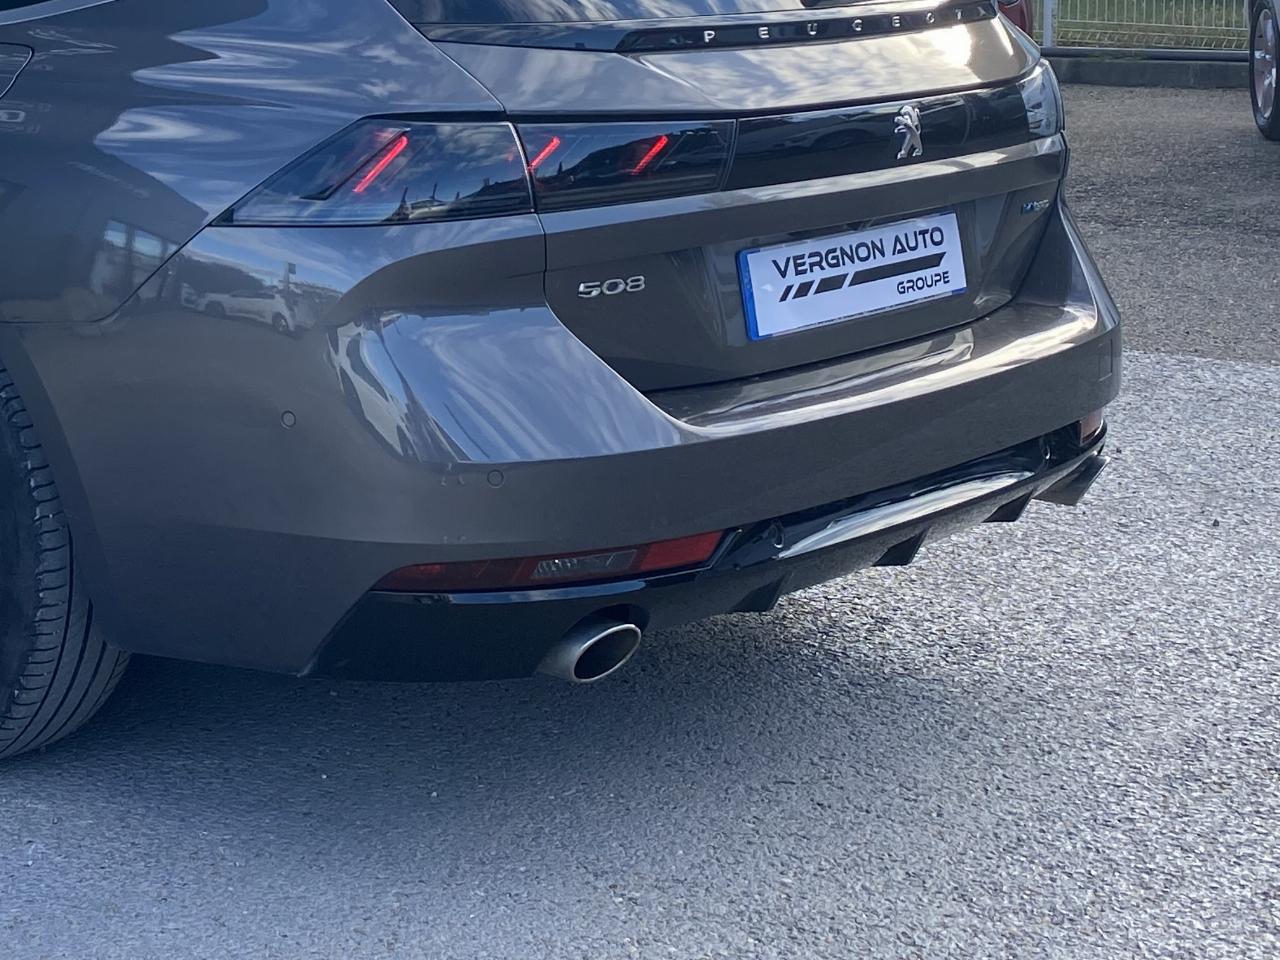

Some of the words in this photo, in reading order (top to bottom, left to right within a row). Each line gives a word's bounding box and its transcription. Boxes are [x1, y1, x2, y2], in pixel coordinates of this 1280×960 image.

[704, 8, 963, 42] PEUGEOT
[772, 238, 885, 279] VERGNON
[892, 226, 944, 256] AUTO
[578, 276, 646, 297] 508
[897, 271, 950, 294] GROUPE
